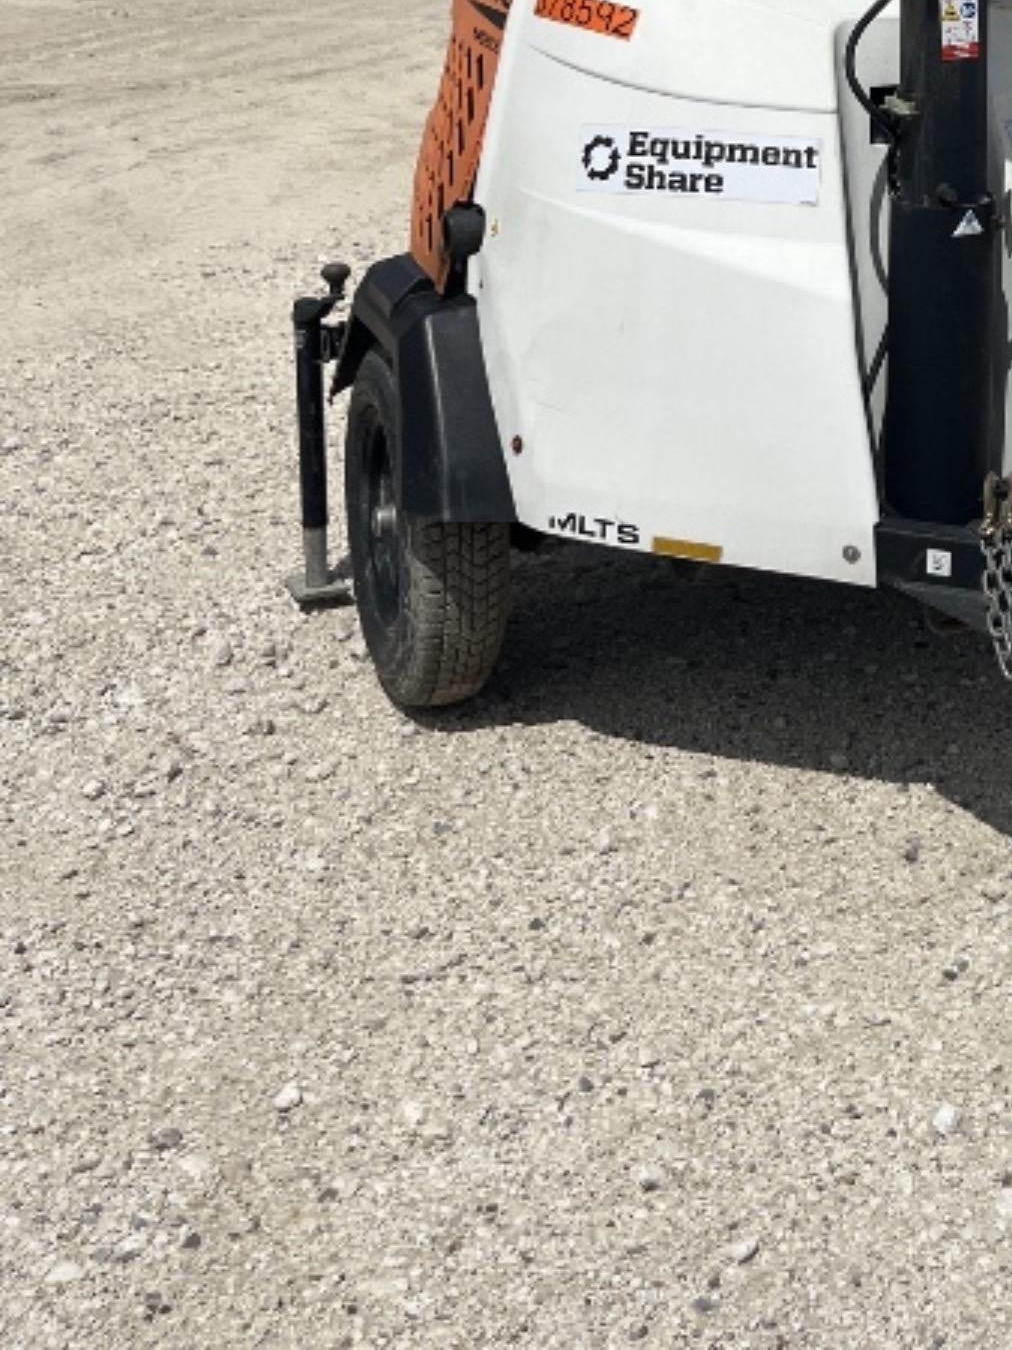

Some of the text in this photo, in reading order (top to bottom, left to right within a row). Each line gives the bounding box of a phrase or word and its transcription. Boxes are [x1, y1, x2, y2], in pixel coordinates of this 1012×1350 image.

[626, 130, 819, 169] Equipment
[624, 162, 724, 194] Share
[548, 512, 640, 544] MLTS
